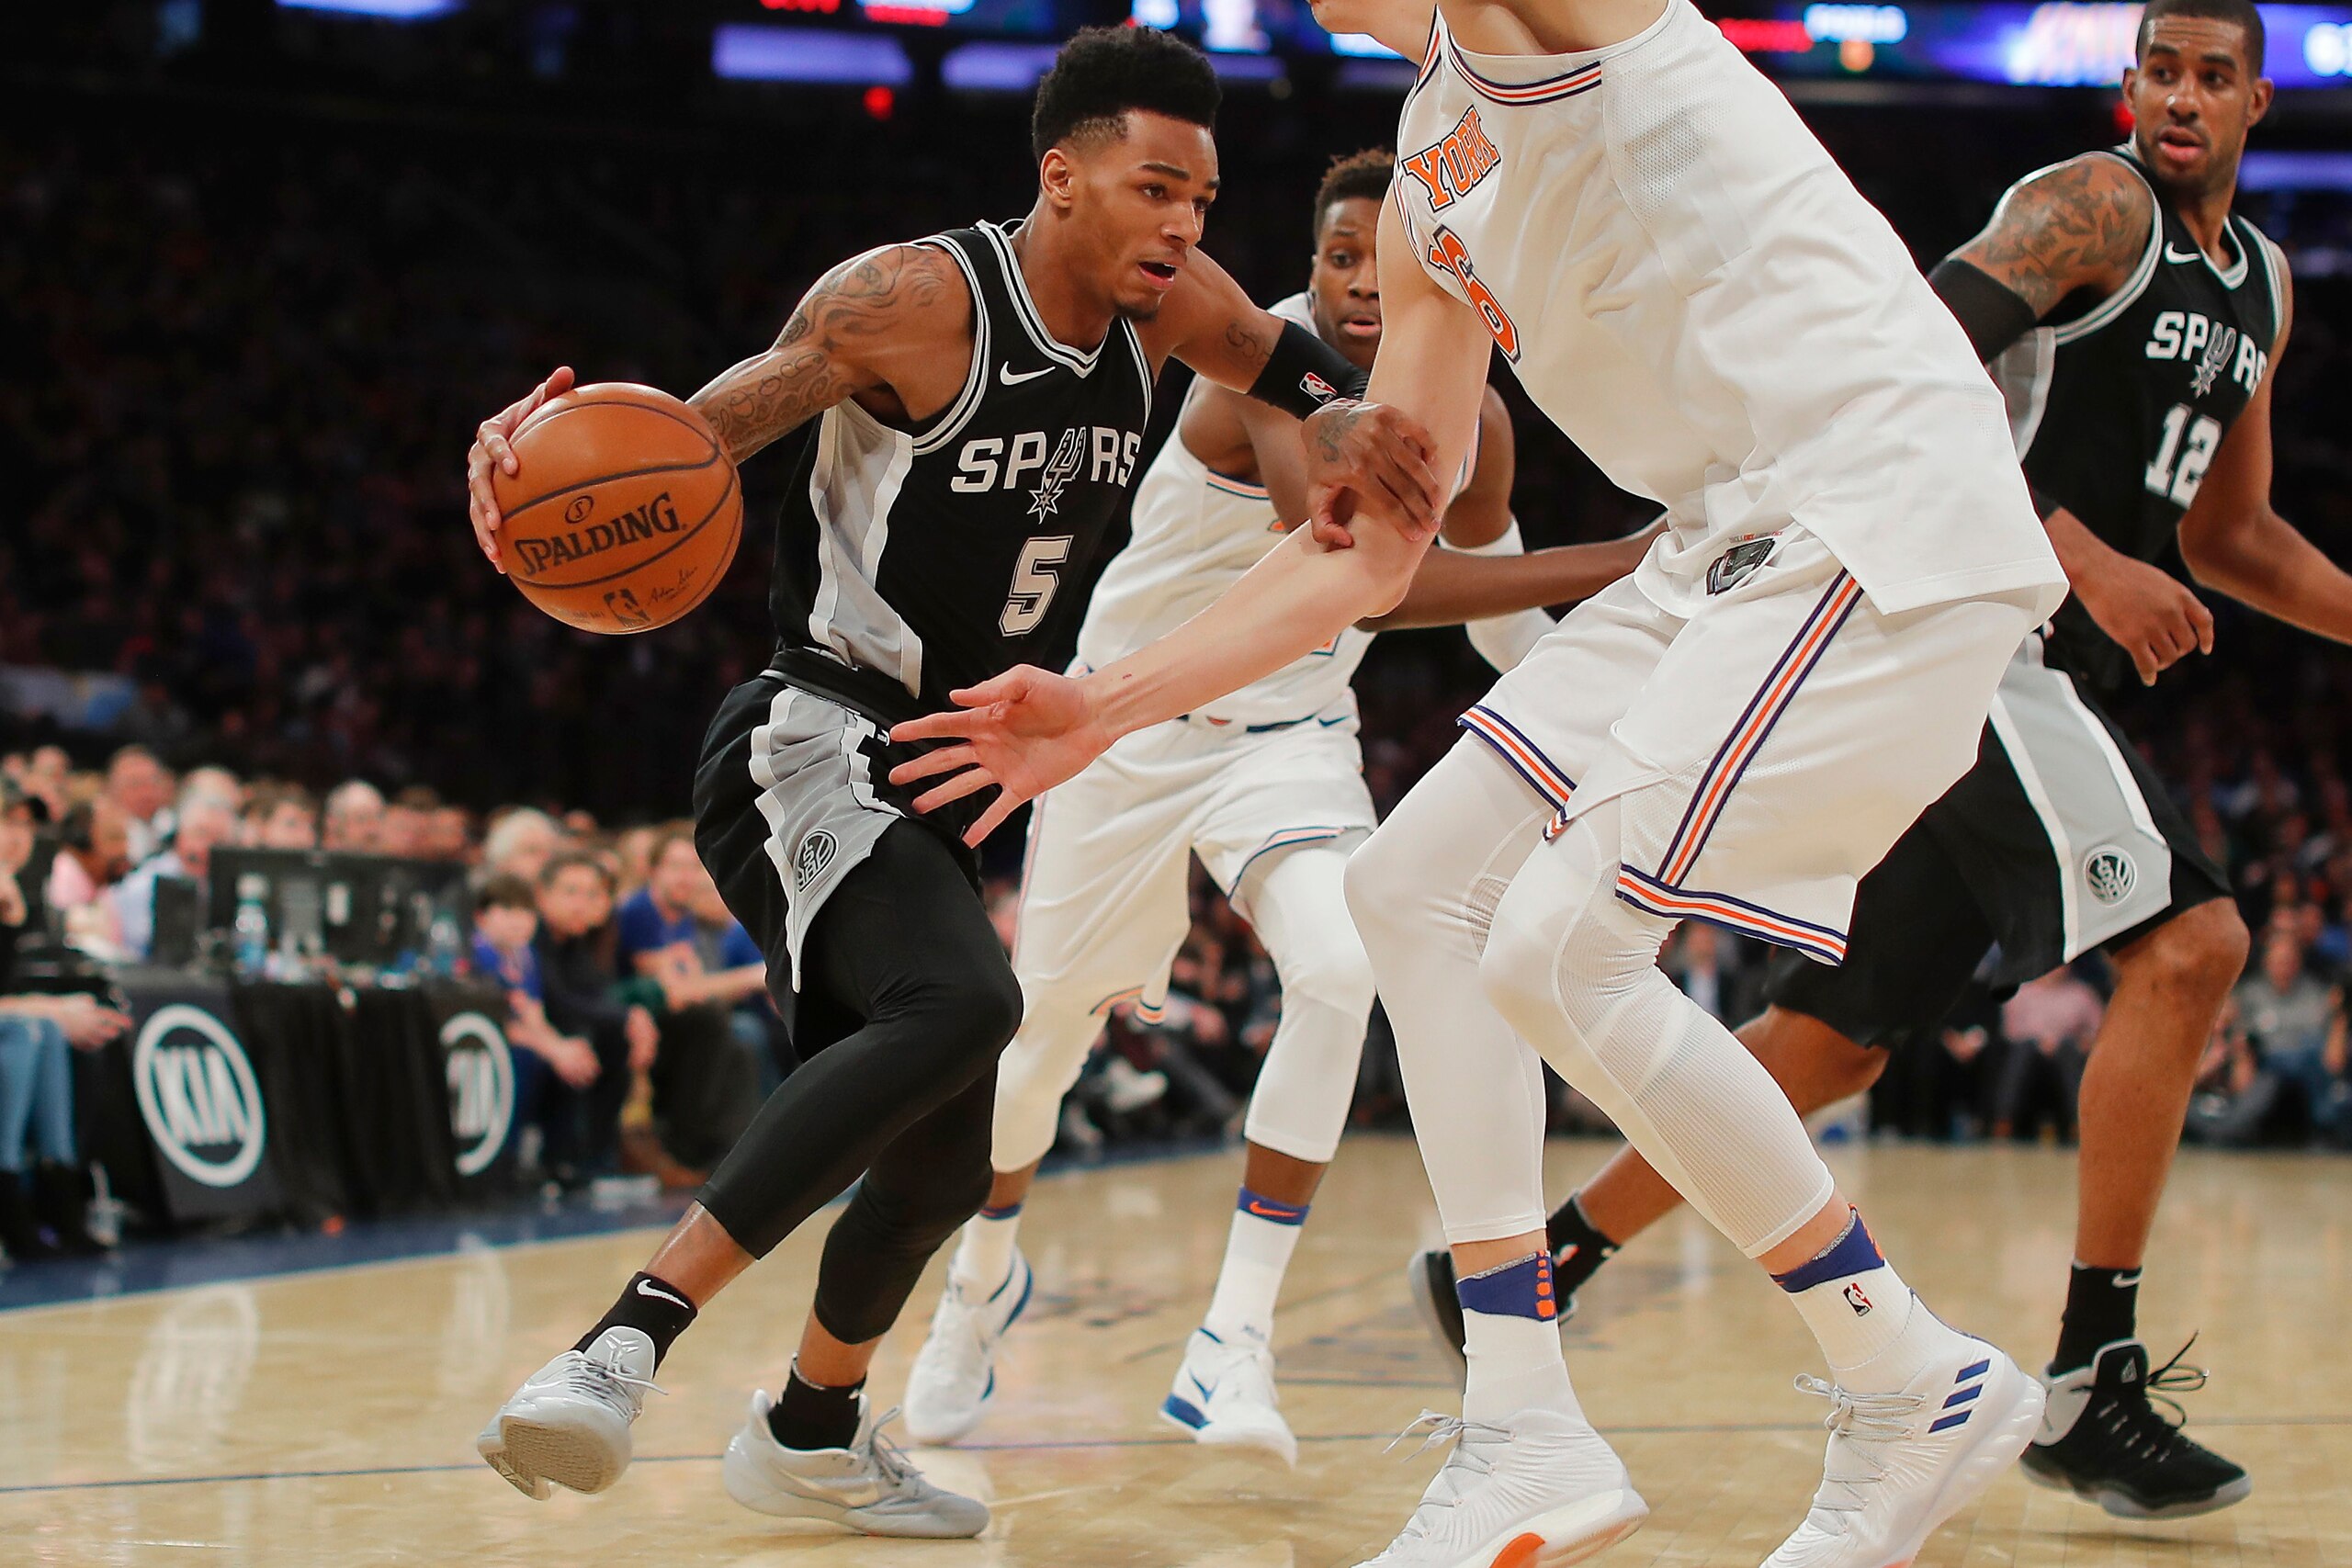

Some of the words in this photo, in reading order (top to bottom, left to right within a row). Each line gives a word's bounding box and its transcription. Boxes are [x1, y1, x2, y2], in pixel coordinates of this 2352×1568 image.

[1401, 104, 1501, 212] YORK
[950, 425, 1143, 525] SPURS
[2144, 402, 2223, 510] 12
[515, 491, 681, 576] SPALDING
[998, 535, 1075, 637] 5
[154, 1045, 247, 1146] KIA
